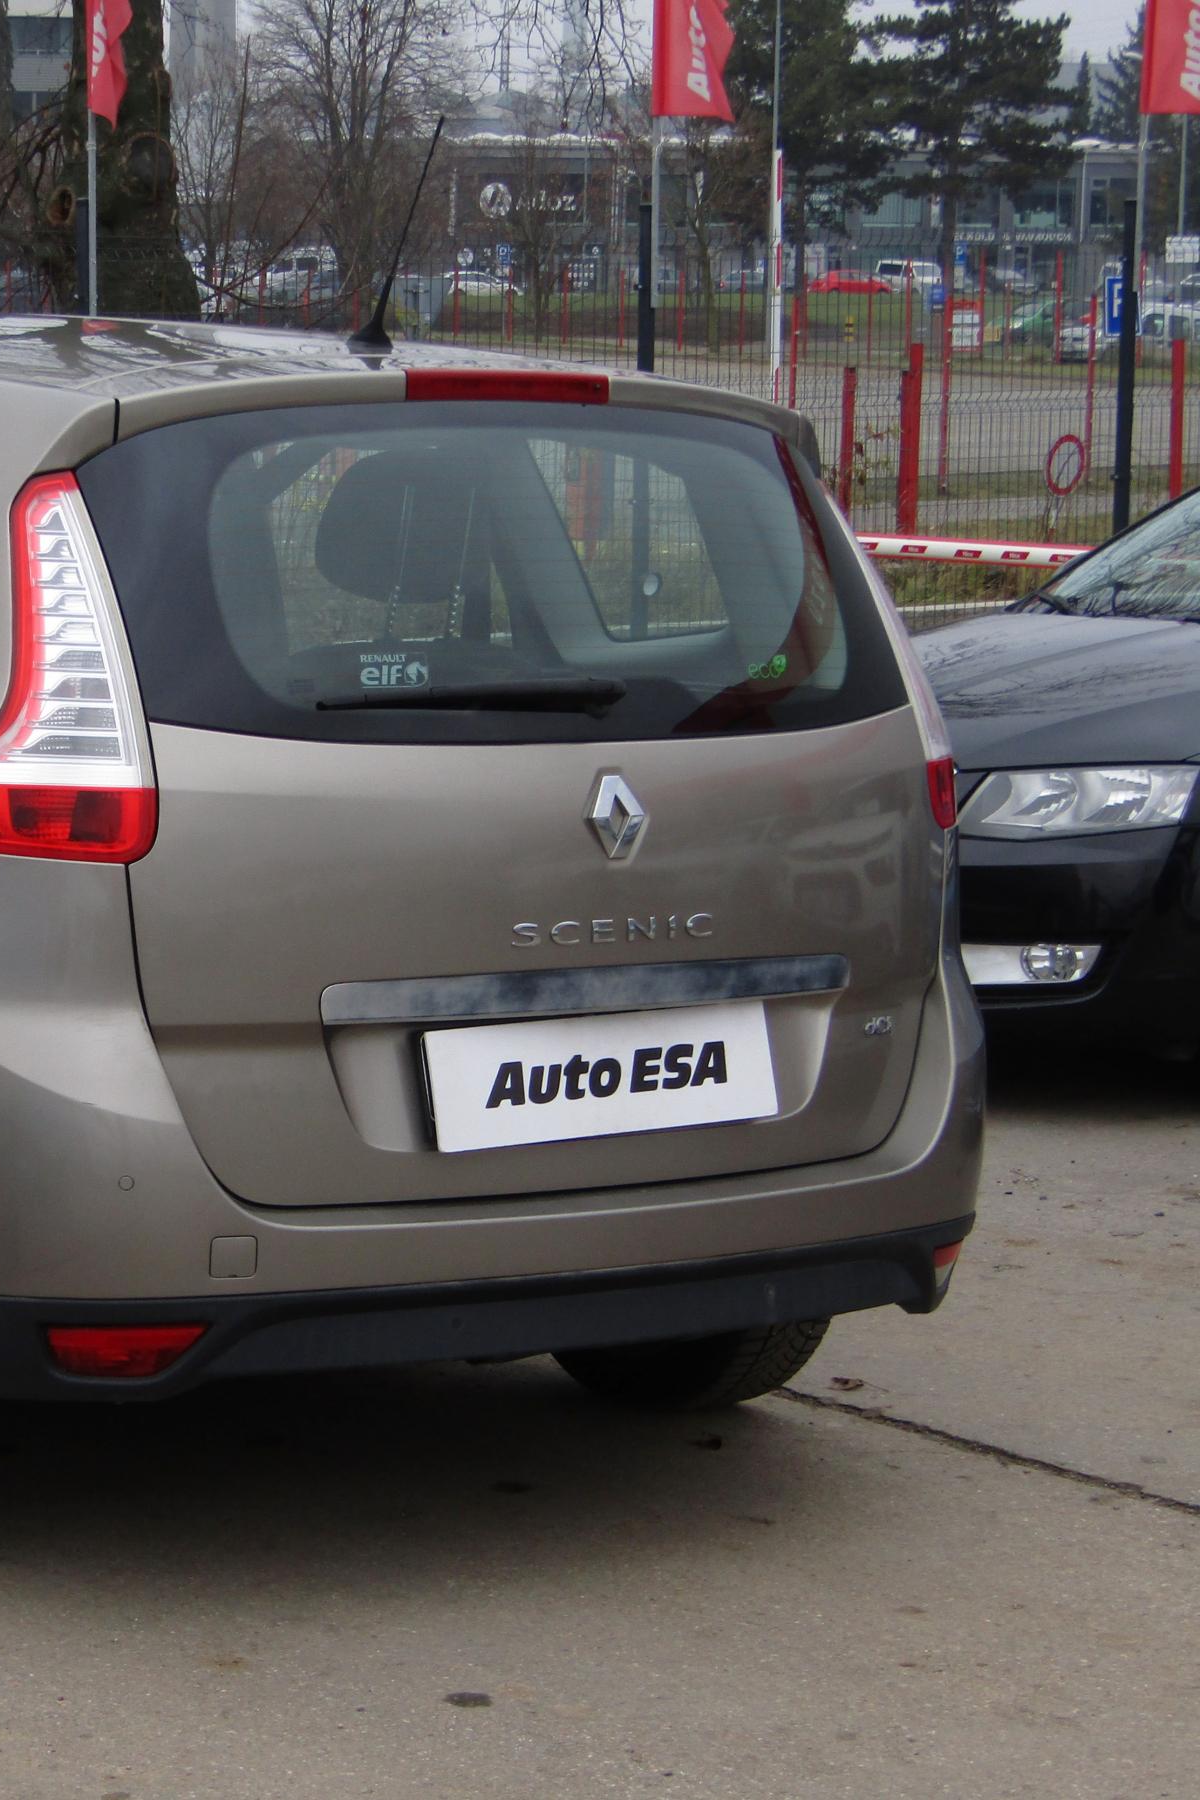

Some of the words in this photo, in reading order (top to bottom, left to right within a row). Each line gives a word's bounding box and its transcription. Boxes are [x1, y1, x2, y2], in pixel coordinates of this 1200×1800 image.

[360, 654, 407, 663] RENAULT
[360, 664, 402, 685] elf
[511, 913, 713, 947] SCENIC
[485, 1054, 622, 1109] Auto
[629, 1040, 728, 1093] ESA
